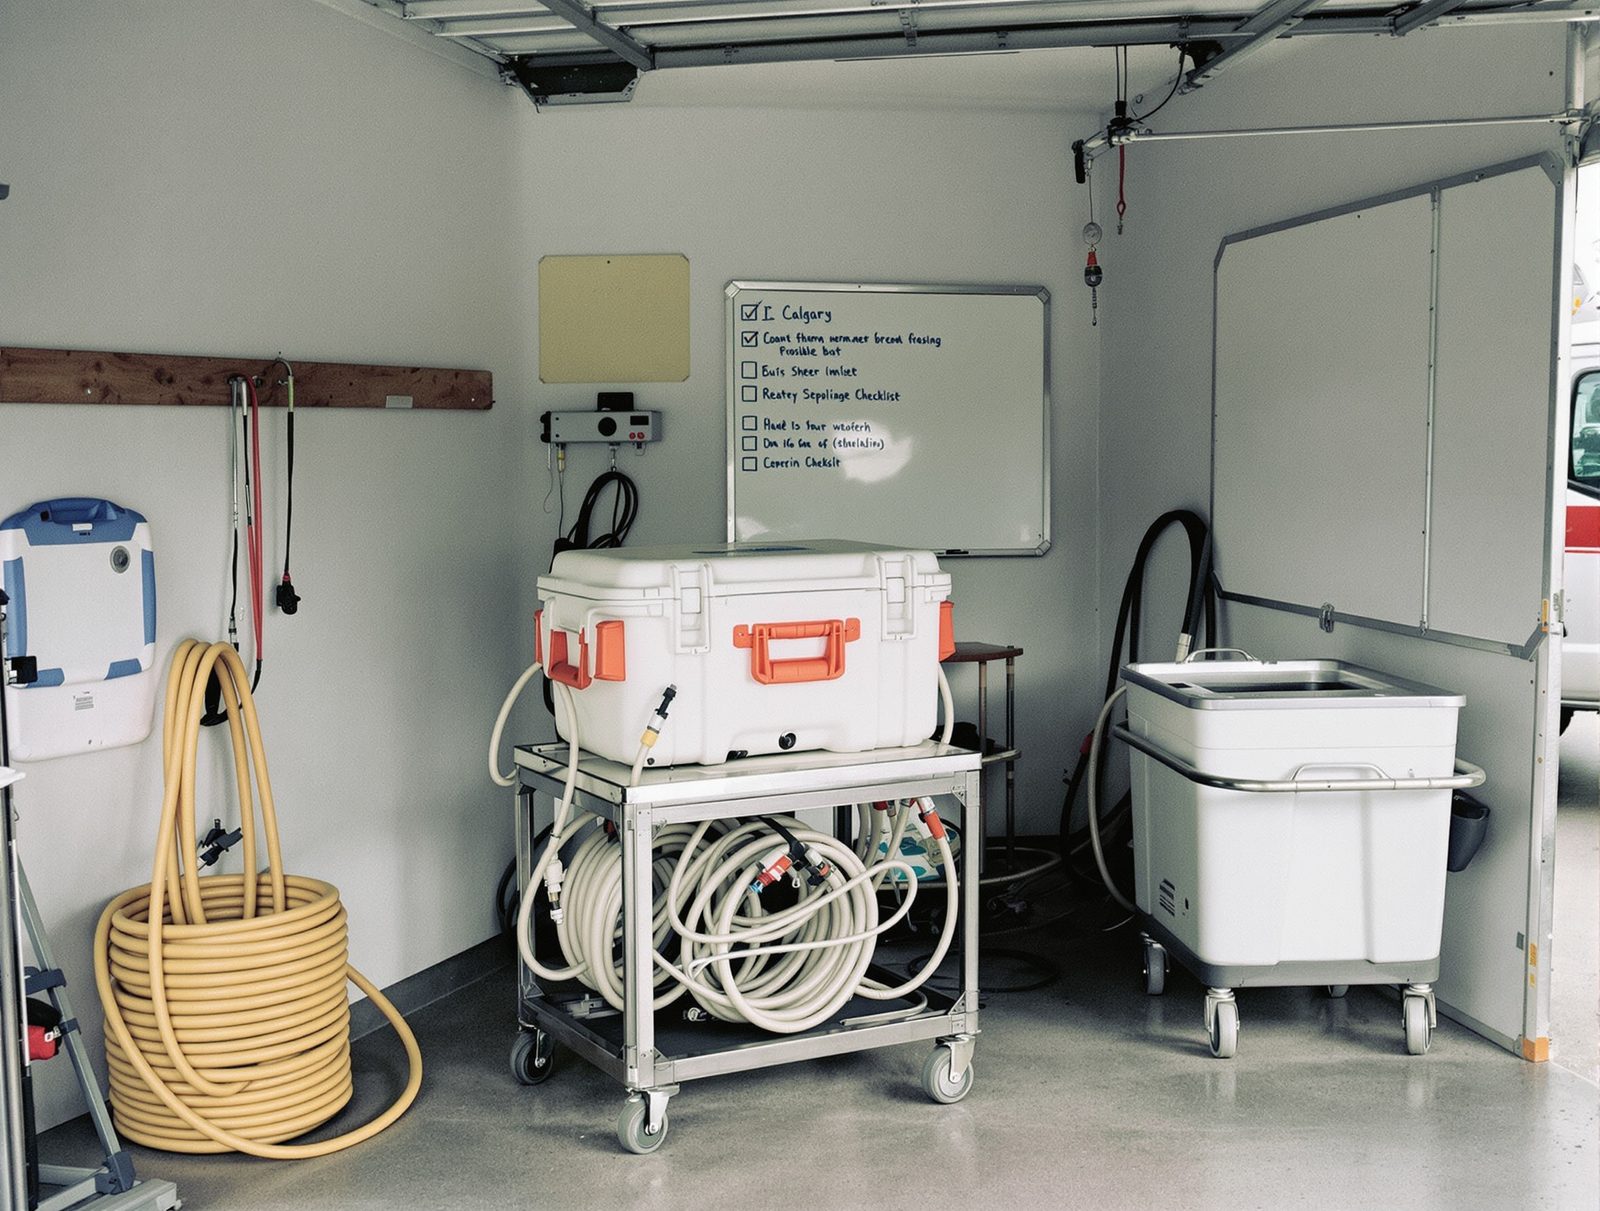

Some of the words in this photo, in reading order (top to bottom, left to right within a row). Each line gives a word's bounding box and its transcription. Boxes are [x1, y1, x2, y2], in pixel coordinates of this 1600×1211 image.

[782, 305, 833, 324] Calgary
[791, 365, 820, 377] Sheer
[855, 388, 901, 402] Checklist
